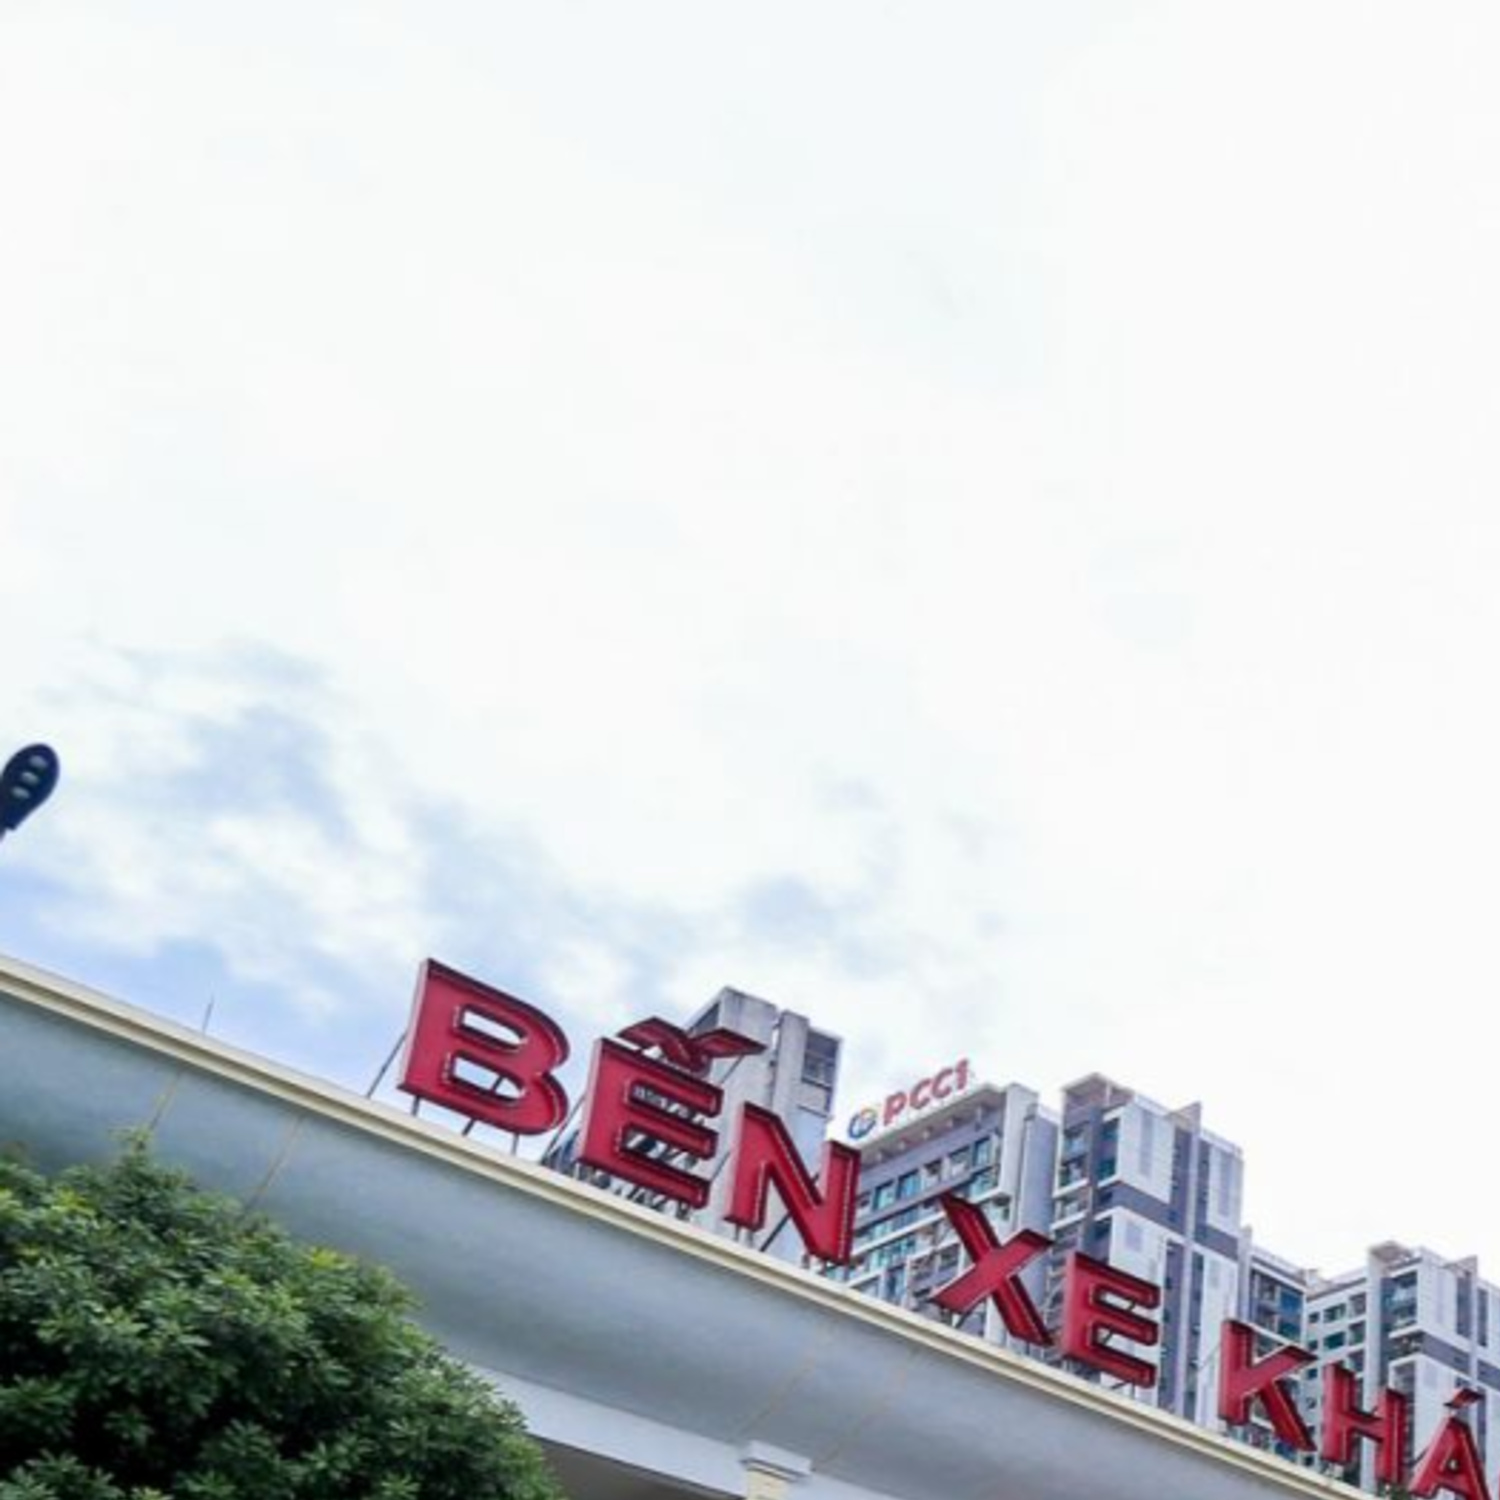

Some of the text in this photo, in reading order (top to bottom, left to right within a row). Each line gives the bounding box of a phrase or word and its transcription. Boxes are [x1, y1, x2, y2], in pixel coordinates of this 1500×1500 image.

[398, 958, 860, 1265] BẾN
[931, 1191, 1160, 1388] XE
[883, 1058, 969, 1127] PCC1
